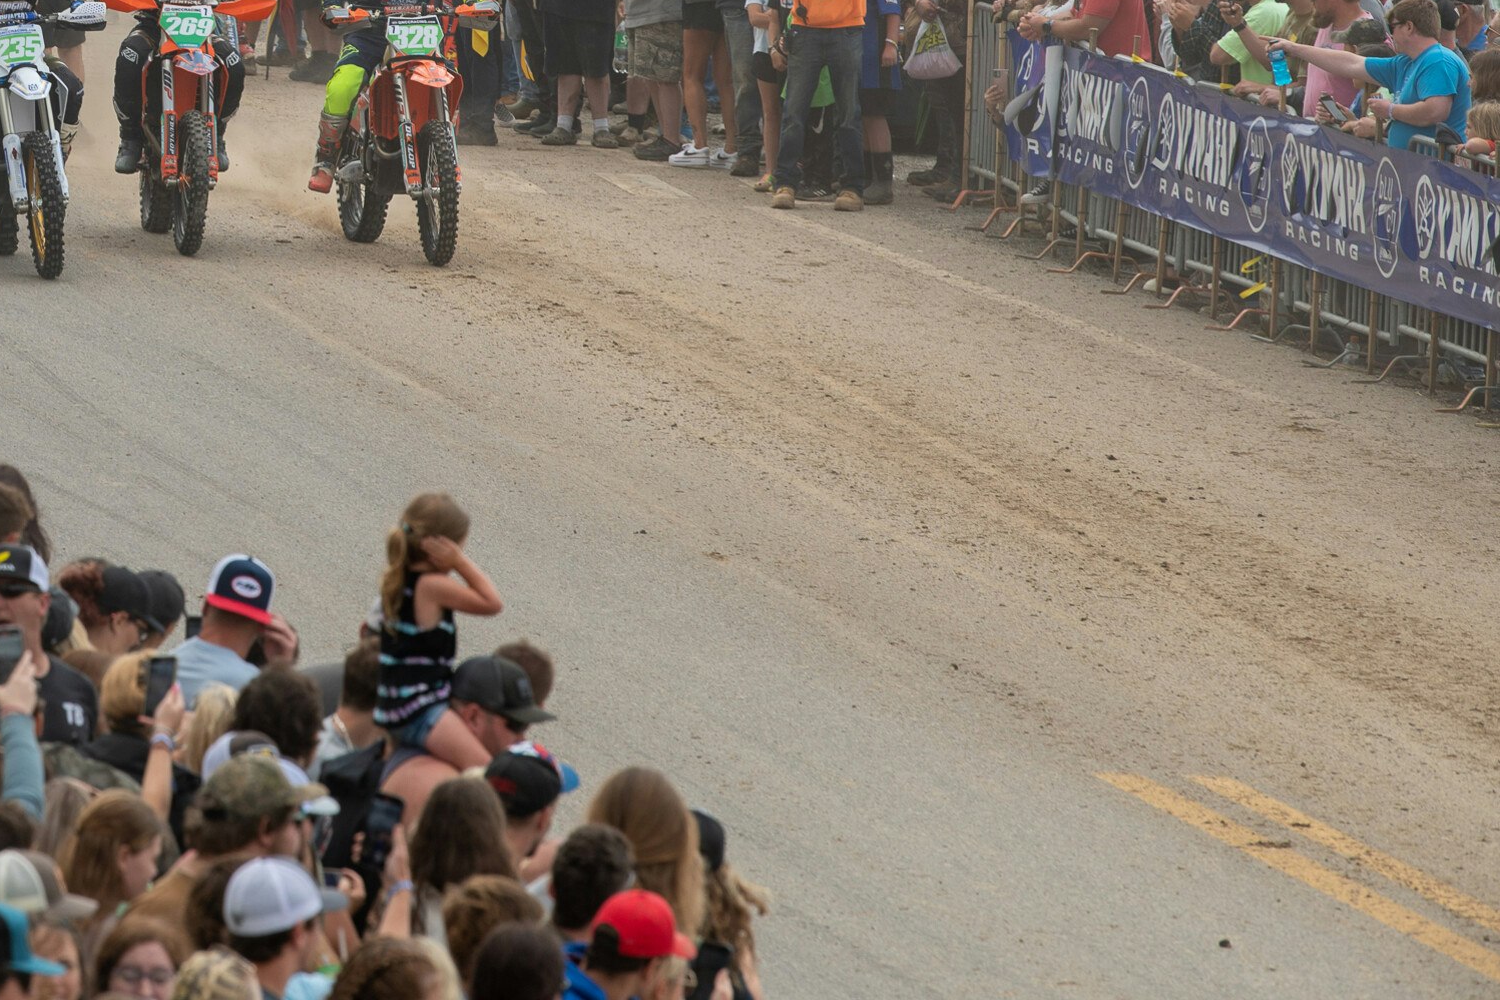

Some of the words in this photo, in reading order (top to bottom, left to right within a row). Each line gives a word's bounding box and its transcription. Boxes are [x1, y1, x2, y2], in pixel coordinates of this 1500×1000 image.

[165, 16, 214, 37] 269
[393, 25, 439, 49] 328
[1057, 143, 1114, 175] RACING
[1159, 177, 1231, 217] RACING
[1285, 219, 1360, 262] RACING
